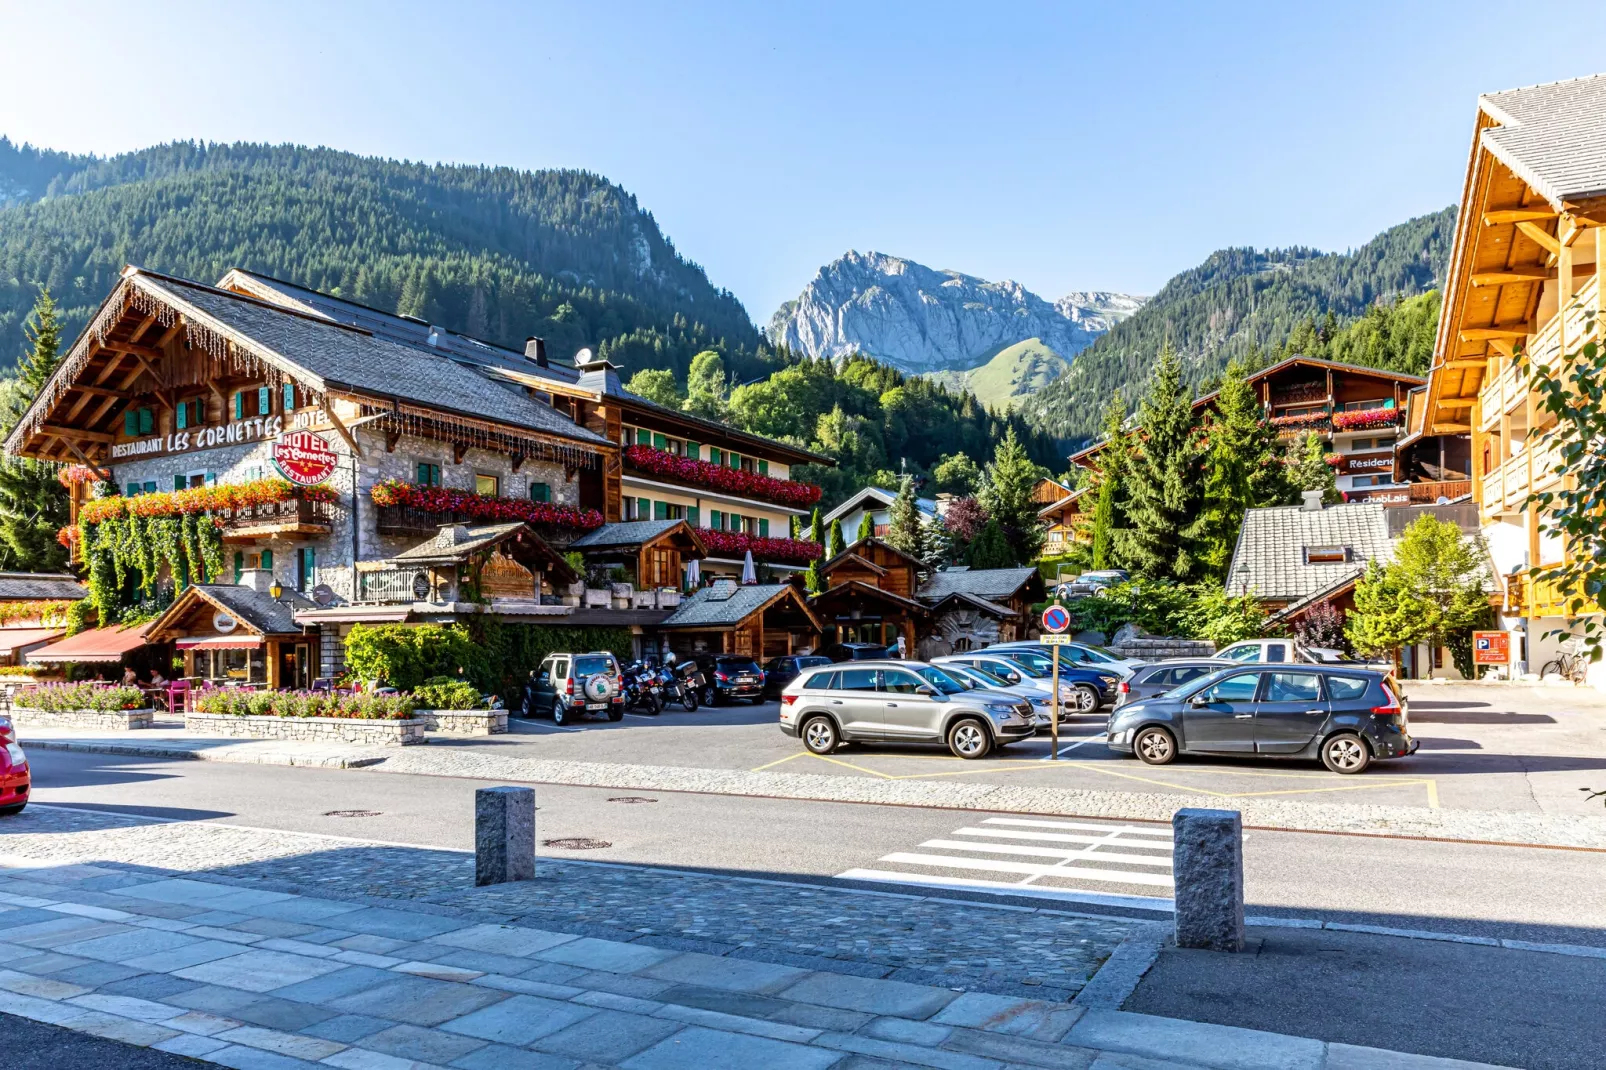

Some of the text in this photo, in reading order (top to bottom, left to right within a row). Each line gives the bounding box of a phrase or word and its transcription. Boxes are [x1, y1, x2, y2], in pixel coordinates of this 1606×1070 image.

[293, 409, 330, 428] HOTEL
[112, 416, 281, 458] RESTAURANT LES CORNETTES
[283, 430, 328, 452] HOTEL
[274, 444, 290, 459] Les
[279, 459, 331, 484] RESTAURANT
[1478, 640, 1488, 649] P
